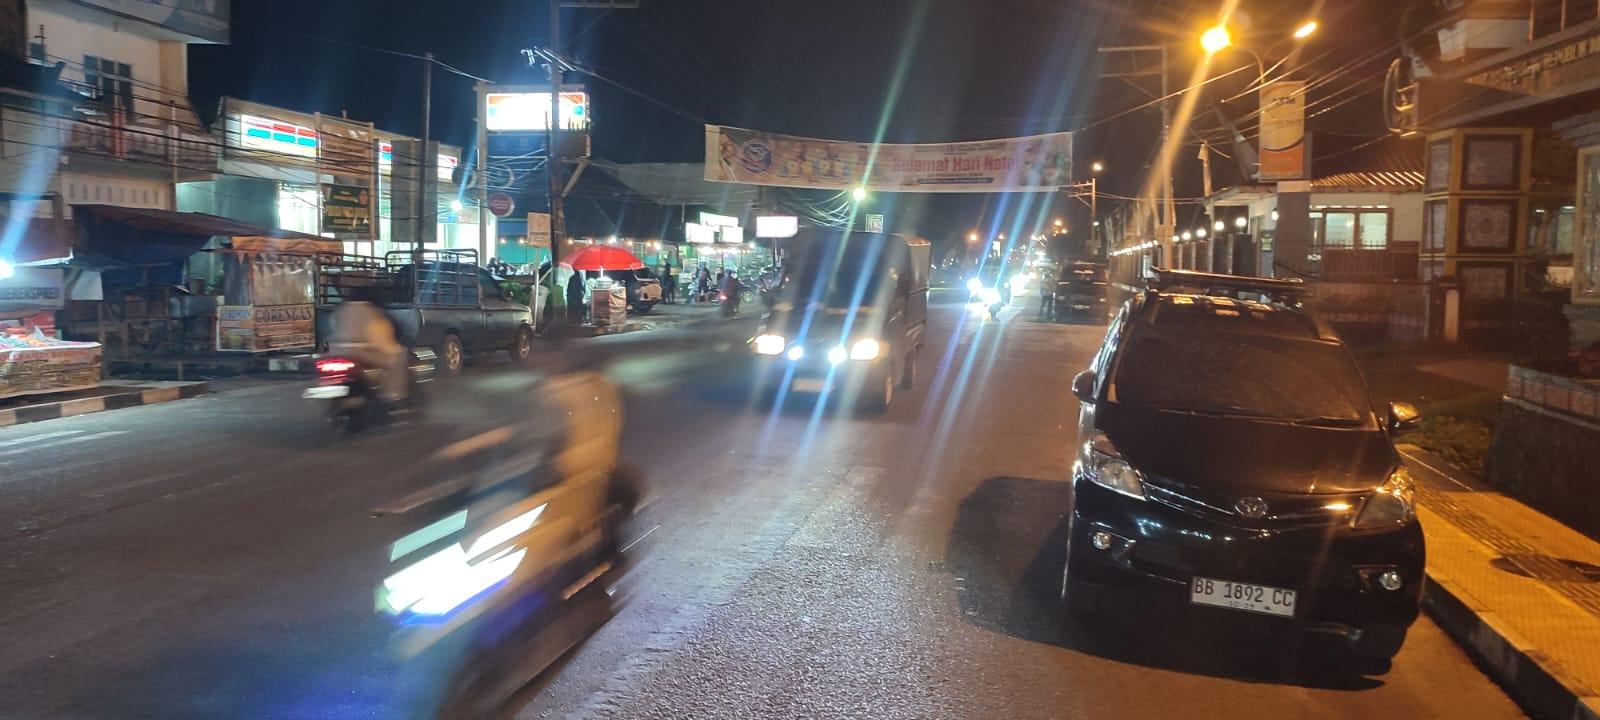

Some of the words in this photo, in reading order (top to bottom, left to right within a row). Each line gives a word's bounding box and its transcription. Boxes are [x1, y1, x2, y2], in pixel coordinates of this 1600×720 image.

[892, 155, 950, 173] Selamat
[952, 155, 980, 172] Hari
[984, 154, 1019, 172] Natal
[254, 308, 312, 323] GORENGAN
[1194, 578, 1214, 595] BB
[1223, 583, 1264, 602] 1892
[1272, 589, 1293, 607] CC
